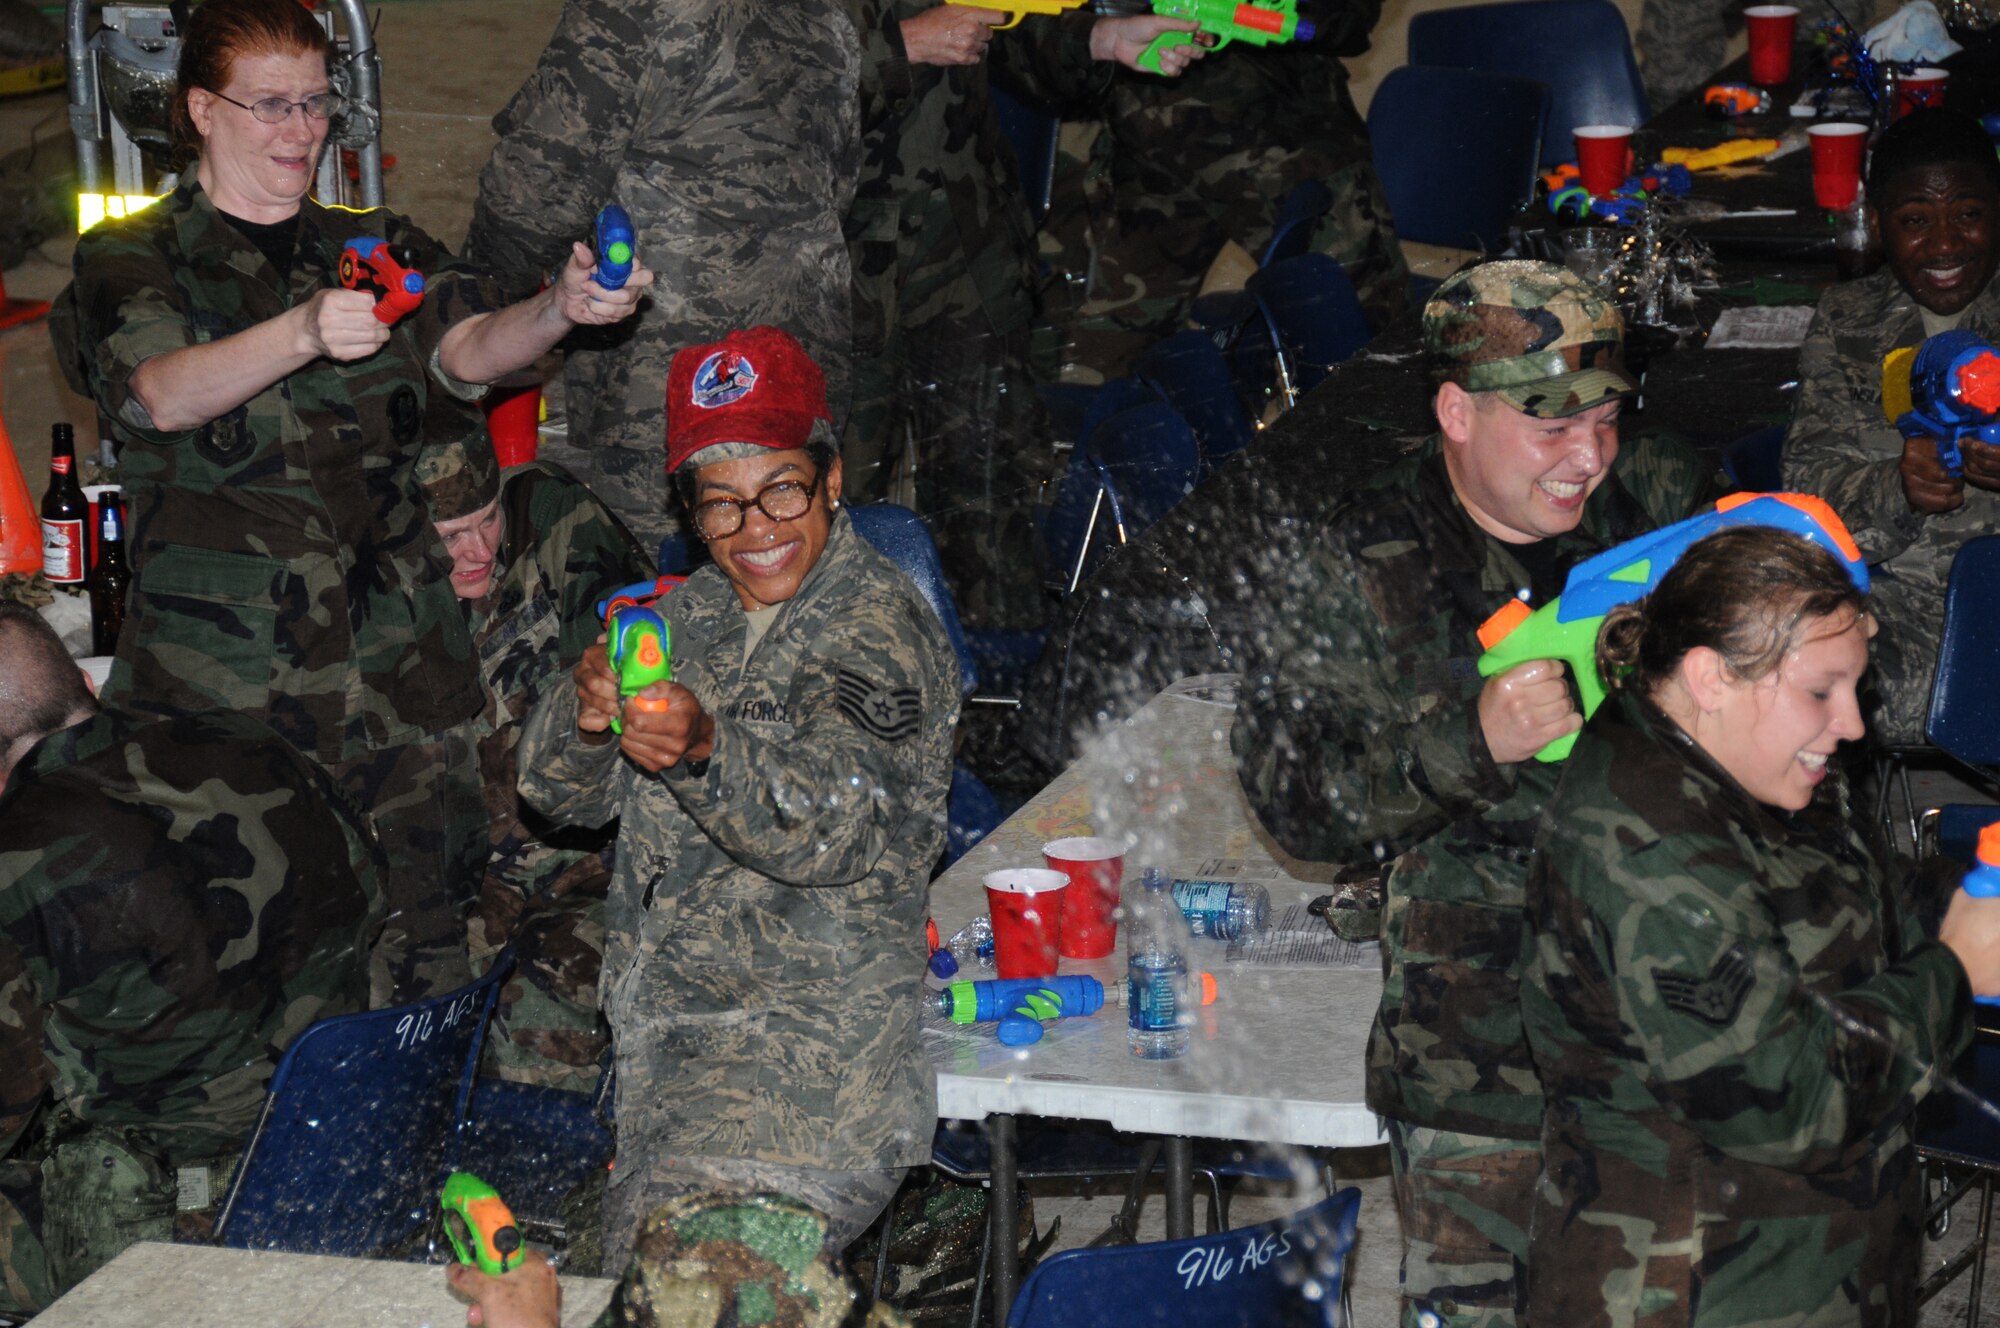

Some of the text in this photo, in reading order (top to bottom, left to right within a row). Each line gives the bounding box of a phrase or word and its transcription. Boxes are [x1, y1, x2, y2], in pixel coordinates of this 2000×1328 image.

[742, 700, 791, 723] FORCE
[395, 1011, 433, 1050] 916
[1177, 1229, 1292, 1290] 916 AGS
